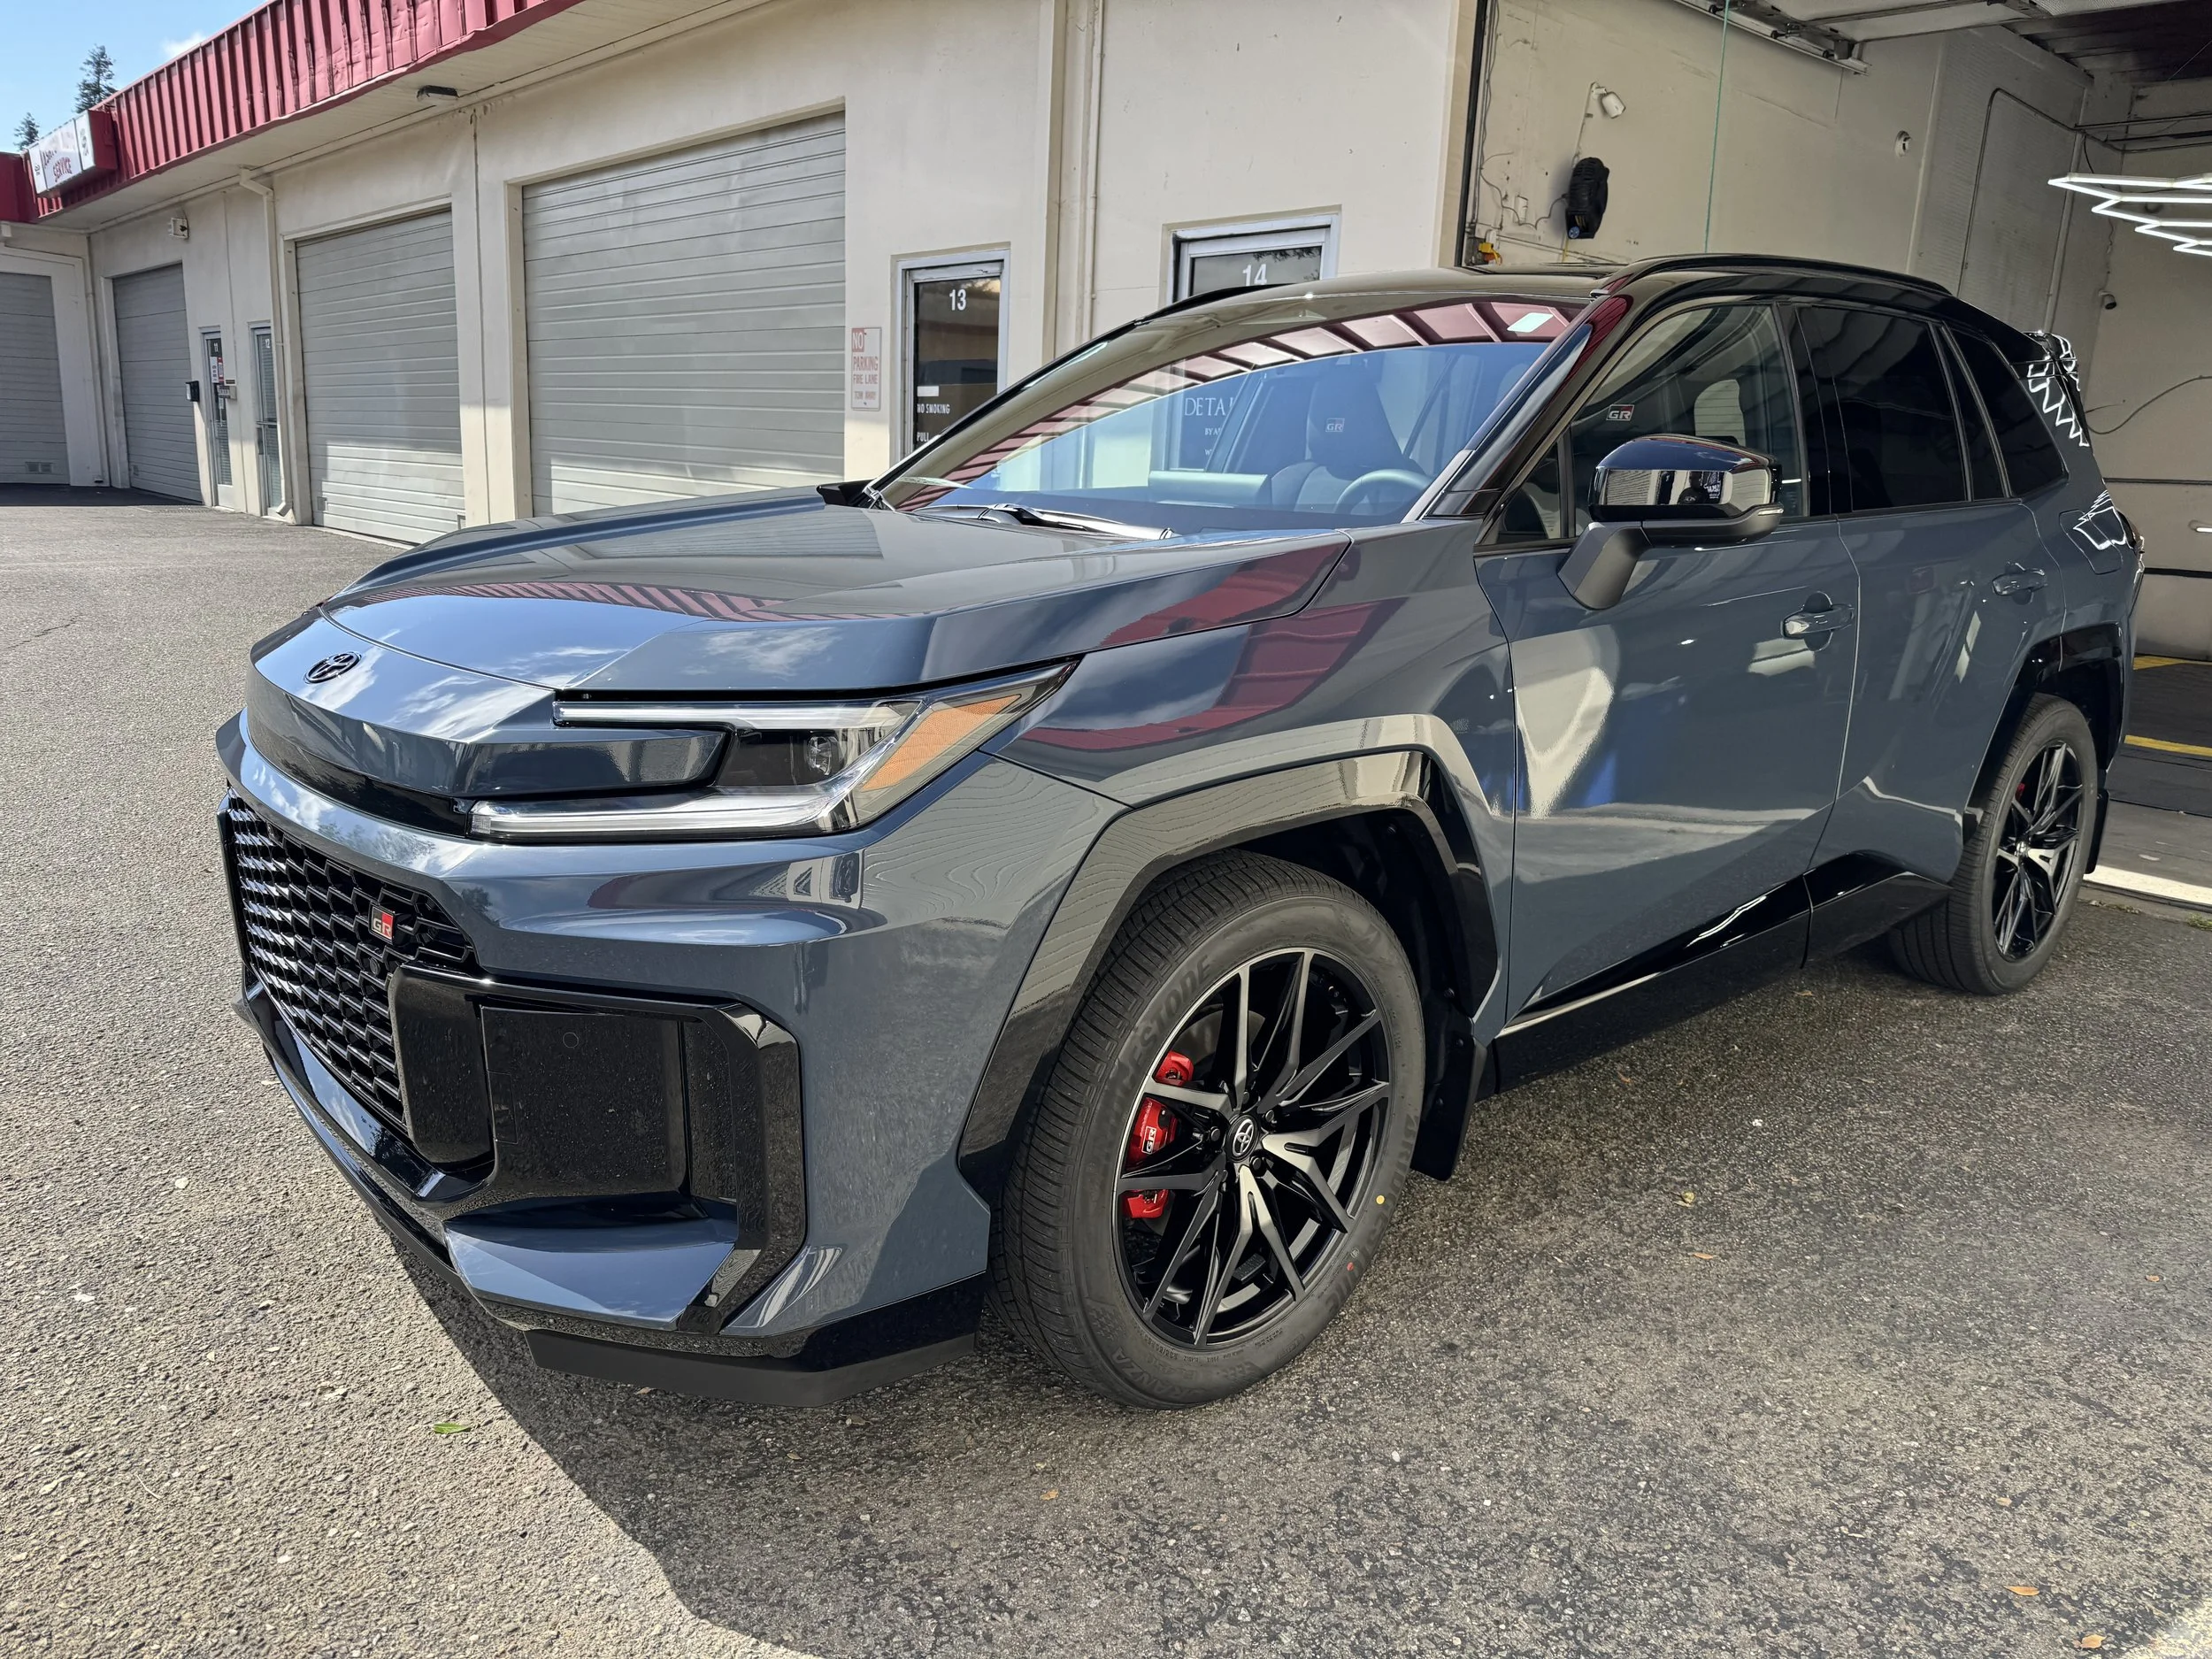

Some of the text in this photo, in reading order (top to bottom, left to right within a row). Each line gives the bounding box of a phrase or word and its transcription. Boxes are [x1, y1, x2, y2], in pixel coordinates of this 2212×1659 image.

[1242, 264, 1267, 287] 14
[949, 288, 967, 311] 13
[852, 332, 864, 349] NO
[853, 356, 879, 371] PARKING
[853, 374, 878, 384] FIRE LANE
[917, 403, 950, 414] NO SMOKING
[373, 918, 393, 938] GR
